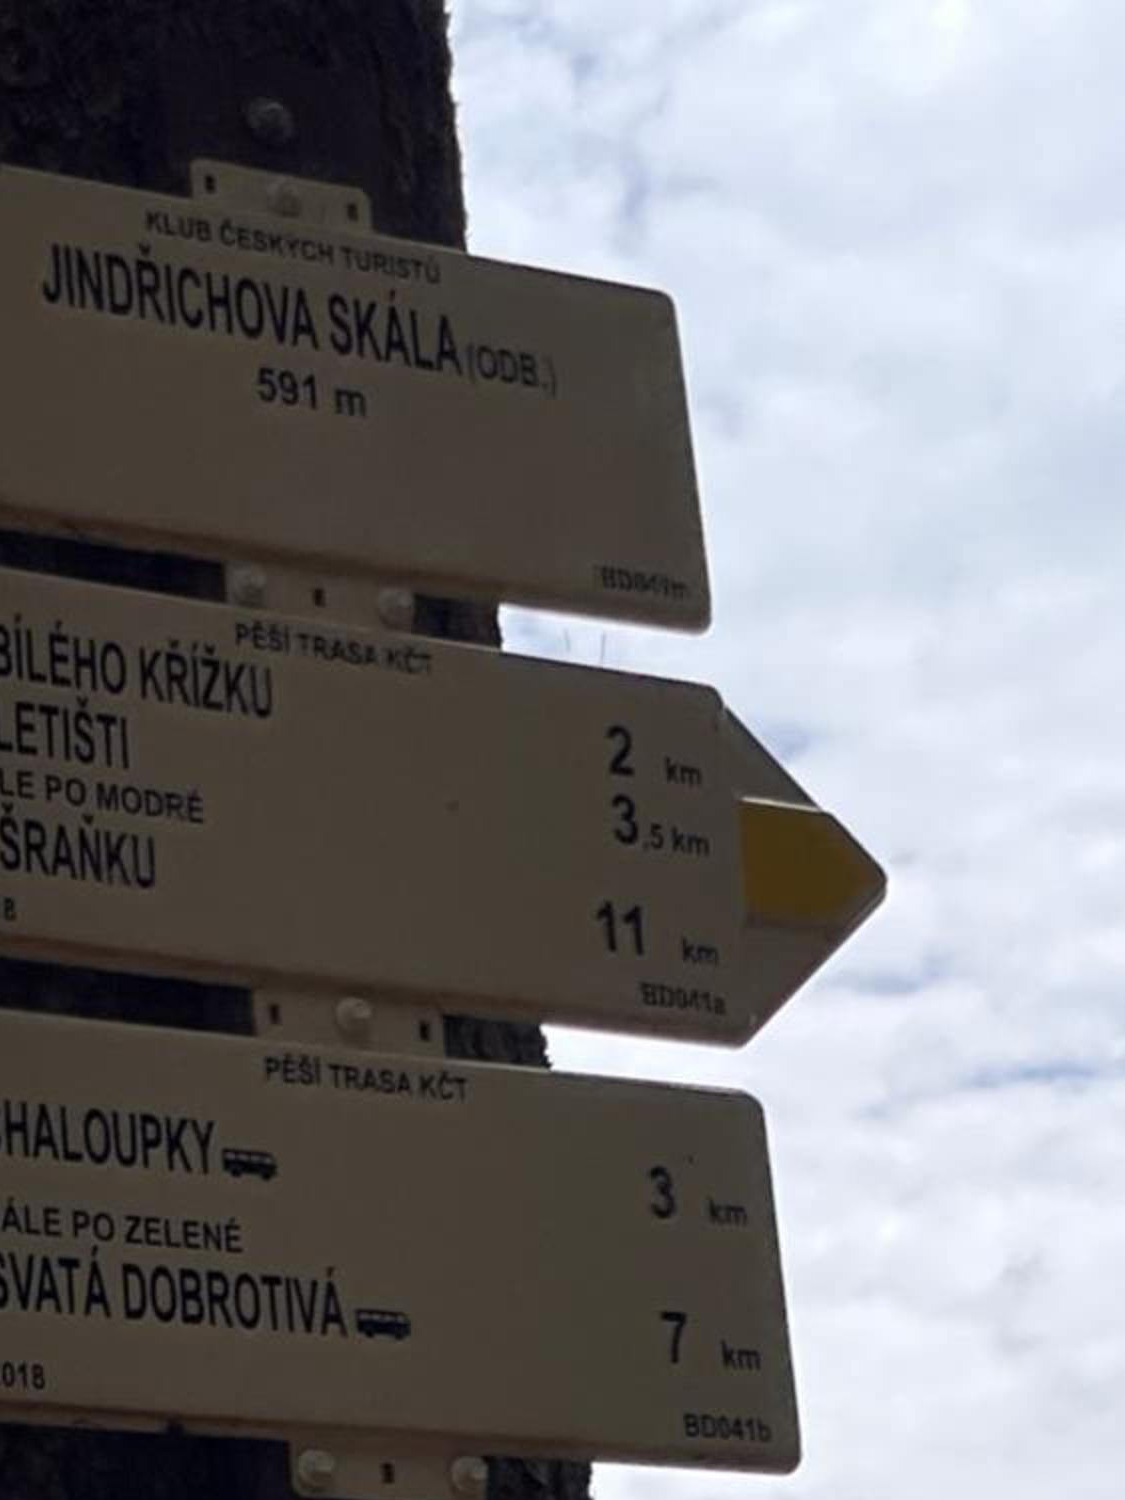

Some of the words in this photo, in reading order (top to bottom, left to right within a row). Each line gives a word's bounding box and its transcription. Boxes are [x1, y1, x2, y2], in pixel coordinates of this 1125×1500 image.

[145, 209, 212, 242] KLUB
[219, 219, 335, 265] ČESKÝCH
[342, 245, 441, 285] TURISTŮ
[42, 242, 320, 351] JINDŘICHOVA
[328, 288, 463, 376] SKÁLA
[465, 342, 557, 398] (ODB.)
[257, 366, 318, 410] 591
[333, 386, 368, 417] m
[297, 631, 377, 666] TRASA
[138, 639, 274, 719] KŘÍŽKU
[606, 725, 635, 776] 2
[665, 755, 702, 786] km
[44, 775, 88, 807] PO
[96, 782, 205, 824] MODRÉ
[672, 825, 711, 856] km
[596, 901, 644, 957] 11
[680, 936, 720, 966] km
[263, 1052, 322, 1086] PĚŠÍ
[327, 1062, 413, 1095] TRASA
[418, 1070, 467, 1101] KČT
[648, 1165, 677, 1220] 3
[706, 1194, 749, 1228] km
[72, 1209, 116, 1243] PO
[124, 1215, 245, 1254] ZELENÉ
[120, 1266, 350, 1337] DOBROTIVÁ
[660, 1311, 687, 1365] 7
[720, 1338, 762, 1371] km
[683, 1412, 774, 1444] BD041b
